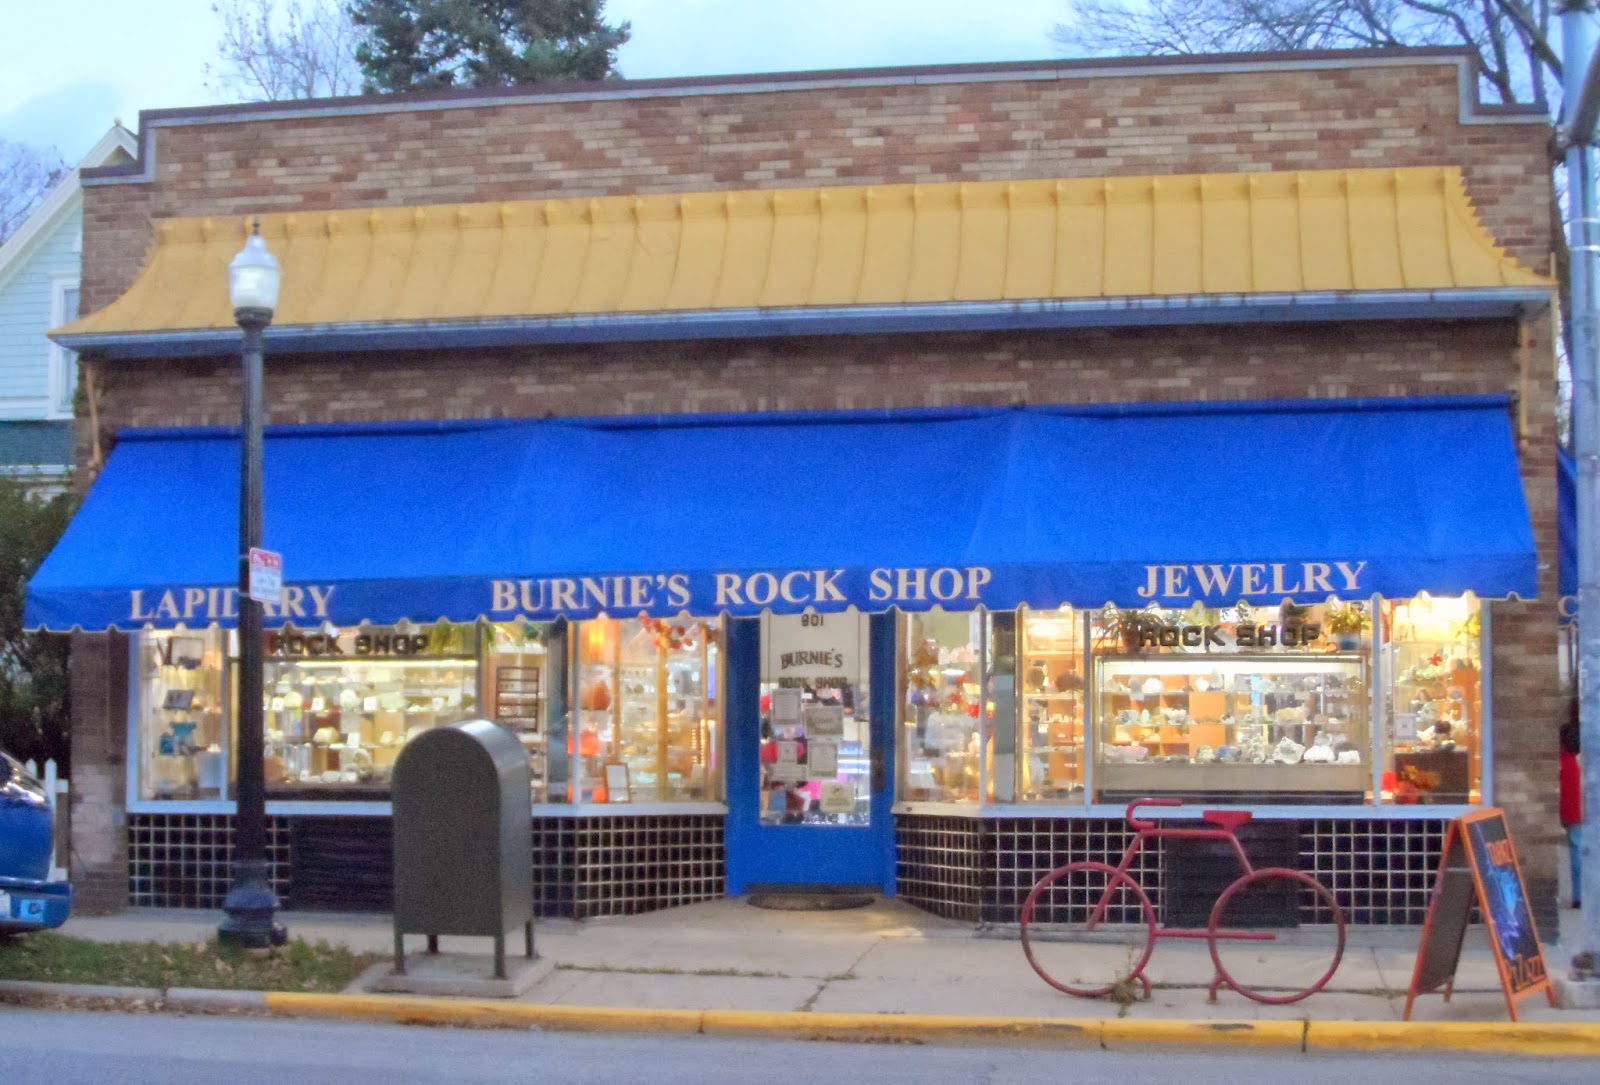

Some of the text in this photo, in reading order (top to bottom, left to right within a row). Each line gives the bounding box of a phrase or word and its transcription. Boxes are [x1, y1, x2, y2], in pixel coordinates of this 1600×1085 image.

[491, 566, 992, 611] BURNIE'S ROCK SHOP
[1137, 561, 1368, 598] JEWELRY
[131, 585, 336, 619] LAPIDRY
[355, 634, 428, 655] SHOP
[1139, 624, 1321, 647] ROCK SHOP
[781, 648, 843, 670] BURNIE'S
